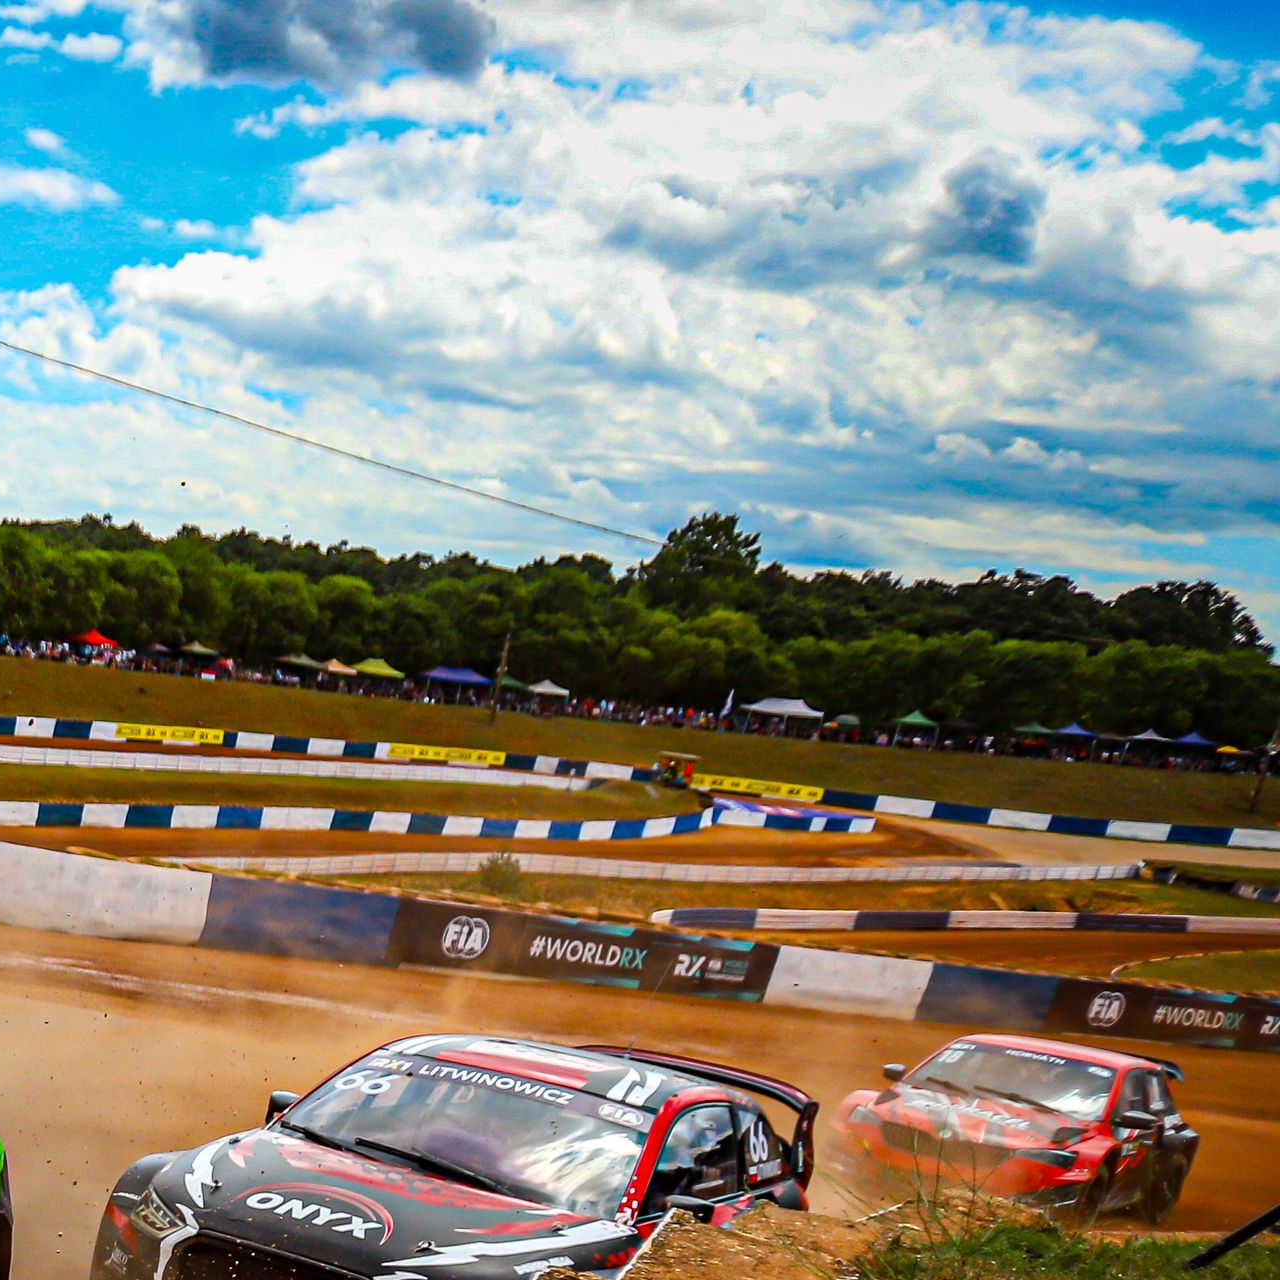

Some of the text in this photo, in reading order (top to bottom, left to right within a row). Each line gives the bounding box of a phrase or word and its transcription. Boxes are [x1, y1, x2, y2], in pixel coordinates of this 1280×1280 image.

[445, 922, 486, 951] FIA
[529, 935, 650, 970] #WORLDRX
[673, 953, 707, 978] RX
[1089, 998, 1122, 1019] FIA
[1152, 1005, 1245, 1031] #WORLDRX
[334, 1069, 402, 1095] 66
[418, 1063, 576, 1106] LITWINOWICZ
[599, 1103, 642, 1124] FIA
[749, 1121, 769, 1163] 66
[245, 1192, 384, 1240] ONYX
